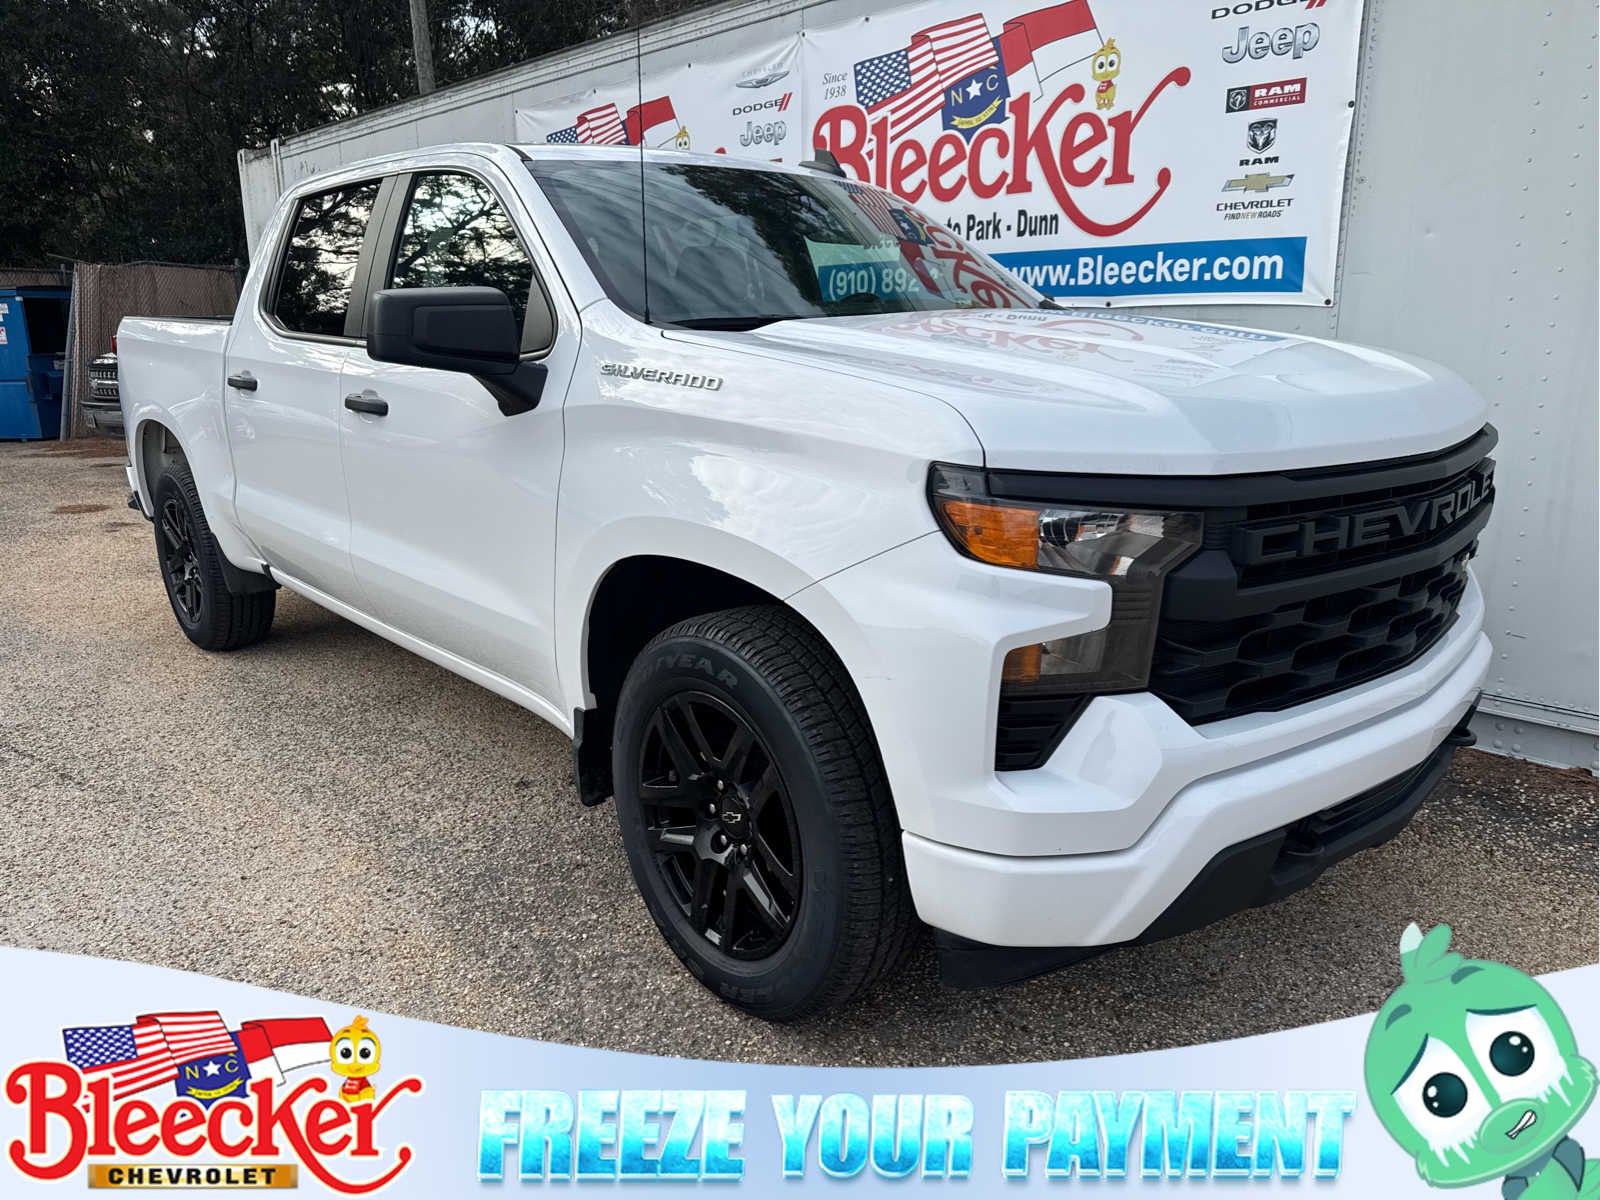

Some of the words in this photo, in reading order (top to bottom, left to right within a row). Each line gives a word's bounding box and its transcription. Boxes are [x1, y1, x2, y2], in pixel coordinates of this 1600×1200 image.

[1211, 0, 1308, 19] DODG
[1222, 22, 1320, 63] Jeep
[822, 72, 848, 85] Since
[951, 88, 963, 106] N
[986, 74, 999, 91] C
[1254, 83, 1301, 98] RAM
[824, 85, 847, 100] 1938
[1253, 95, 1301, 106] COMMERCIAL
[732, 98, 784, 116] DODGE
[739, 120, 787, 147] Jeep
[813, 66, 1191, 237] Bleecker
[1239, 156, 1280, 166] RAM
[1216, 198, 1294, 211] CHEVROLET
[966, 212, 1002, 241] Park
[1016, 209, 1059, 237] Dunn
[1004, 251, 1284, 287] www.Bleecker.com
[829, 267, 877, 301] (910)
[600, 363, 724, 392] SILVERADO
[1238, 471, 1492, 563] CHEVROLE
